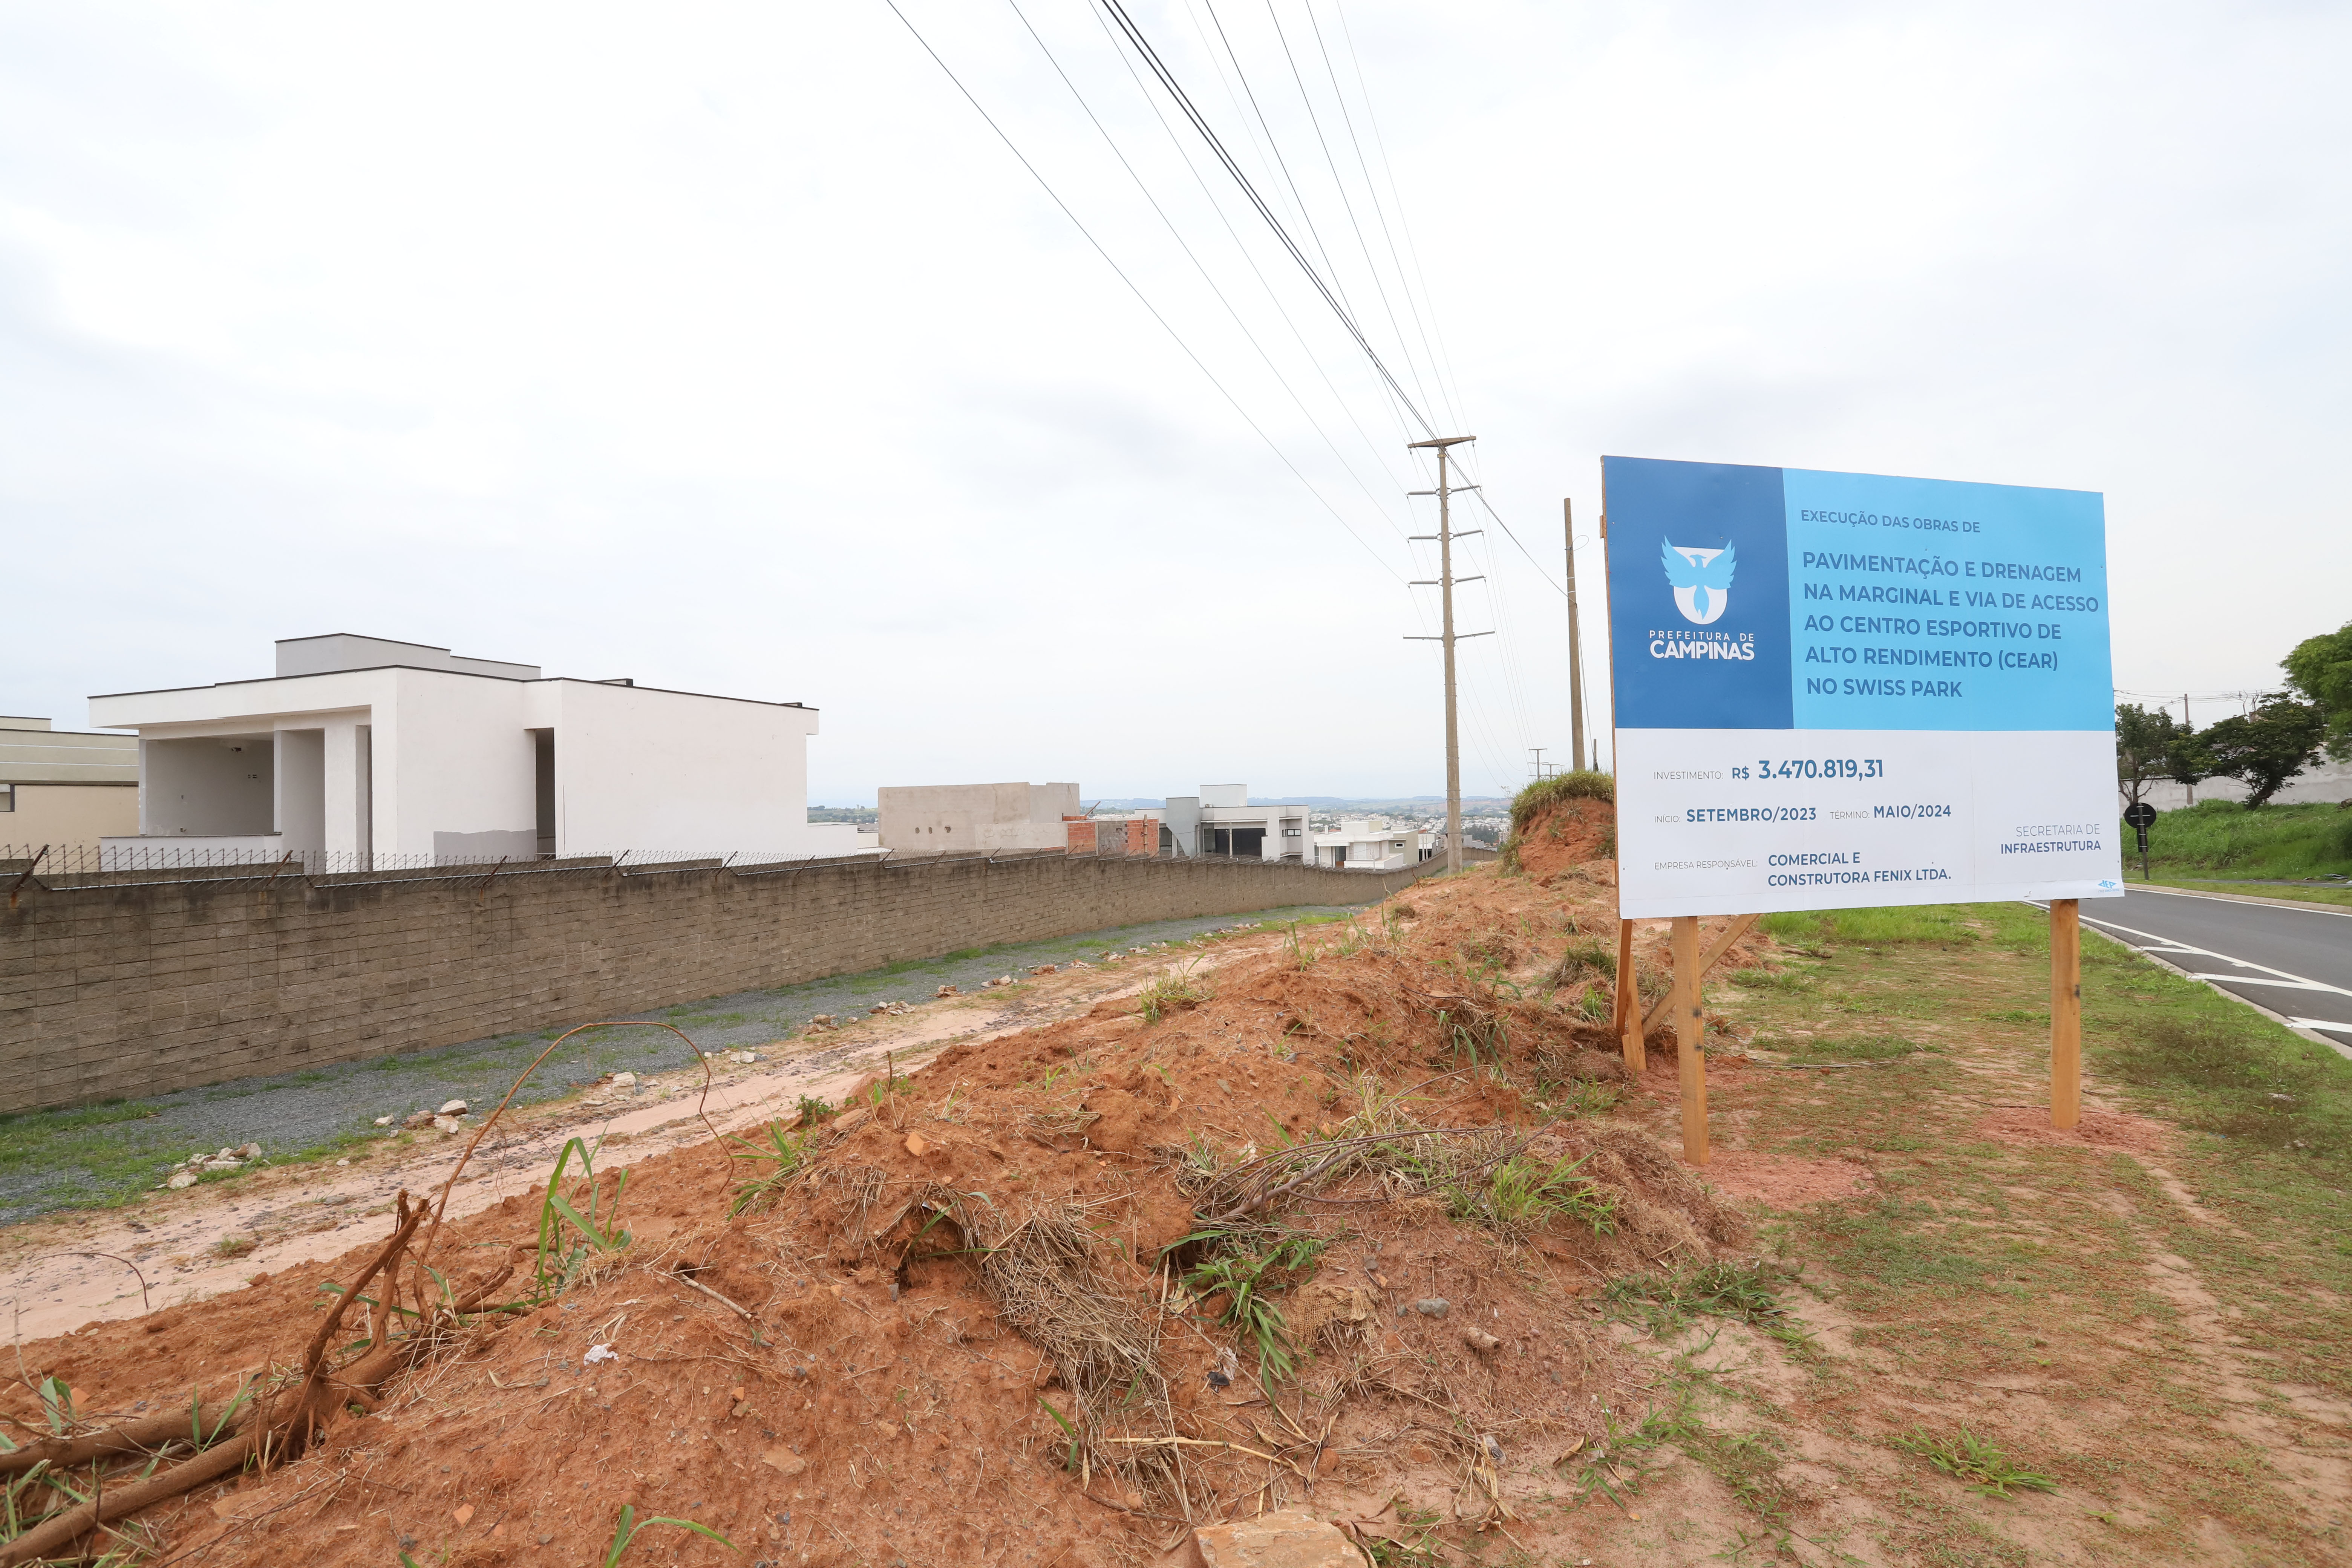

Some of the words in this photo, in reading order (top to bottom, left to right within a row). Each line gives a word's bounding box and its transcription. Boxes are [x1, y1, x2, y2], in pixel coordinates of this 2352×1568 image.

[1801, 510, 1878, 528] EXECUÇÃO
[1882, 515, 1909, 528] DAS
[1913, 518, 1958, 532] OBRAS
[1962, 521, 1980, 533] DE
[1803, 551, 1958, 579] PAVIMENTAÇÃO
[1965, 561, 1976, 577] E
[1981, 562, 2081, 583] DRENAGEM
[1804, 583, 1833, 600] NA
[1839, 585, 1943, 606] MARGINAL
[1949, 590, 1960, 606] E
[1965, 591, 1997, 608] VIA
[2002, 593, 2026, 609] DE
[2031, 594, 2099, 612] ACESSO
[1649, 630, 1730, 641] PREFEITURA
[1740, 633, 1754, 642] DE
[1804, 615, 1834, 632] AO
[1840, 616, 1920, 635] CENTRO
[1926, 620, 2032, 639] ESPORTIVO
[2038, 623, 2061, 639] DE
[1650, 640, 1755, 660] CAMPINAS
[1805, 646, 1857, 664] ALTO
[1864, 648, 1992, 668] RENDIMENTO
[1998, 650, 2058, 671] (CEAR)
[1807, 678, 1837, 695] NO
[1843, 678, 1906, 696] SWISS
[1911, 680, 1963, 697] PARK
[1654, 771, 1724, 779] INVESTIMENTO:
[1732, 766, 1750, 781] R$
[1758, 759, 1883, 781] 3.470.819,31
[1654, 814, 1681, 823] INÍCIO:
[1686, 806, 1816, 823] SETEMBRO/2023
[1830, 810, 1870, 819] TÉRMINO:
[1874, 804, 1951, 819] MAIO/2024
[2016, 824, 2083, 837] SECRETARIA
[2086, 824, 2100, 835] DE
[2001, 840, 2101, 854] INFRAESTRUTURA
[1655, 861, 1694, 870] EMPRESA
[1697, 859, 1758, 869] RESPONSÁVEL:
[1768, 853, 1849, 866] COMERCIAL
[1853, 852, 1860, 864] E
[1768, 871, 1870, 887] CONSTRUTORA
[1874, 870, 1912, 882] FENIX
[1916, 868, 1951, 880] LTDA.
